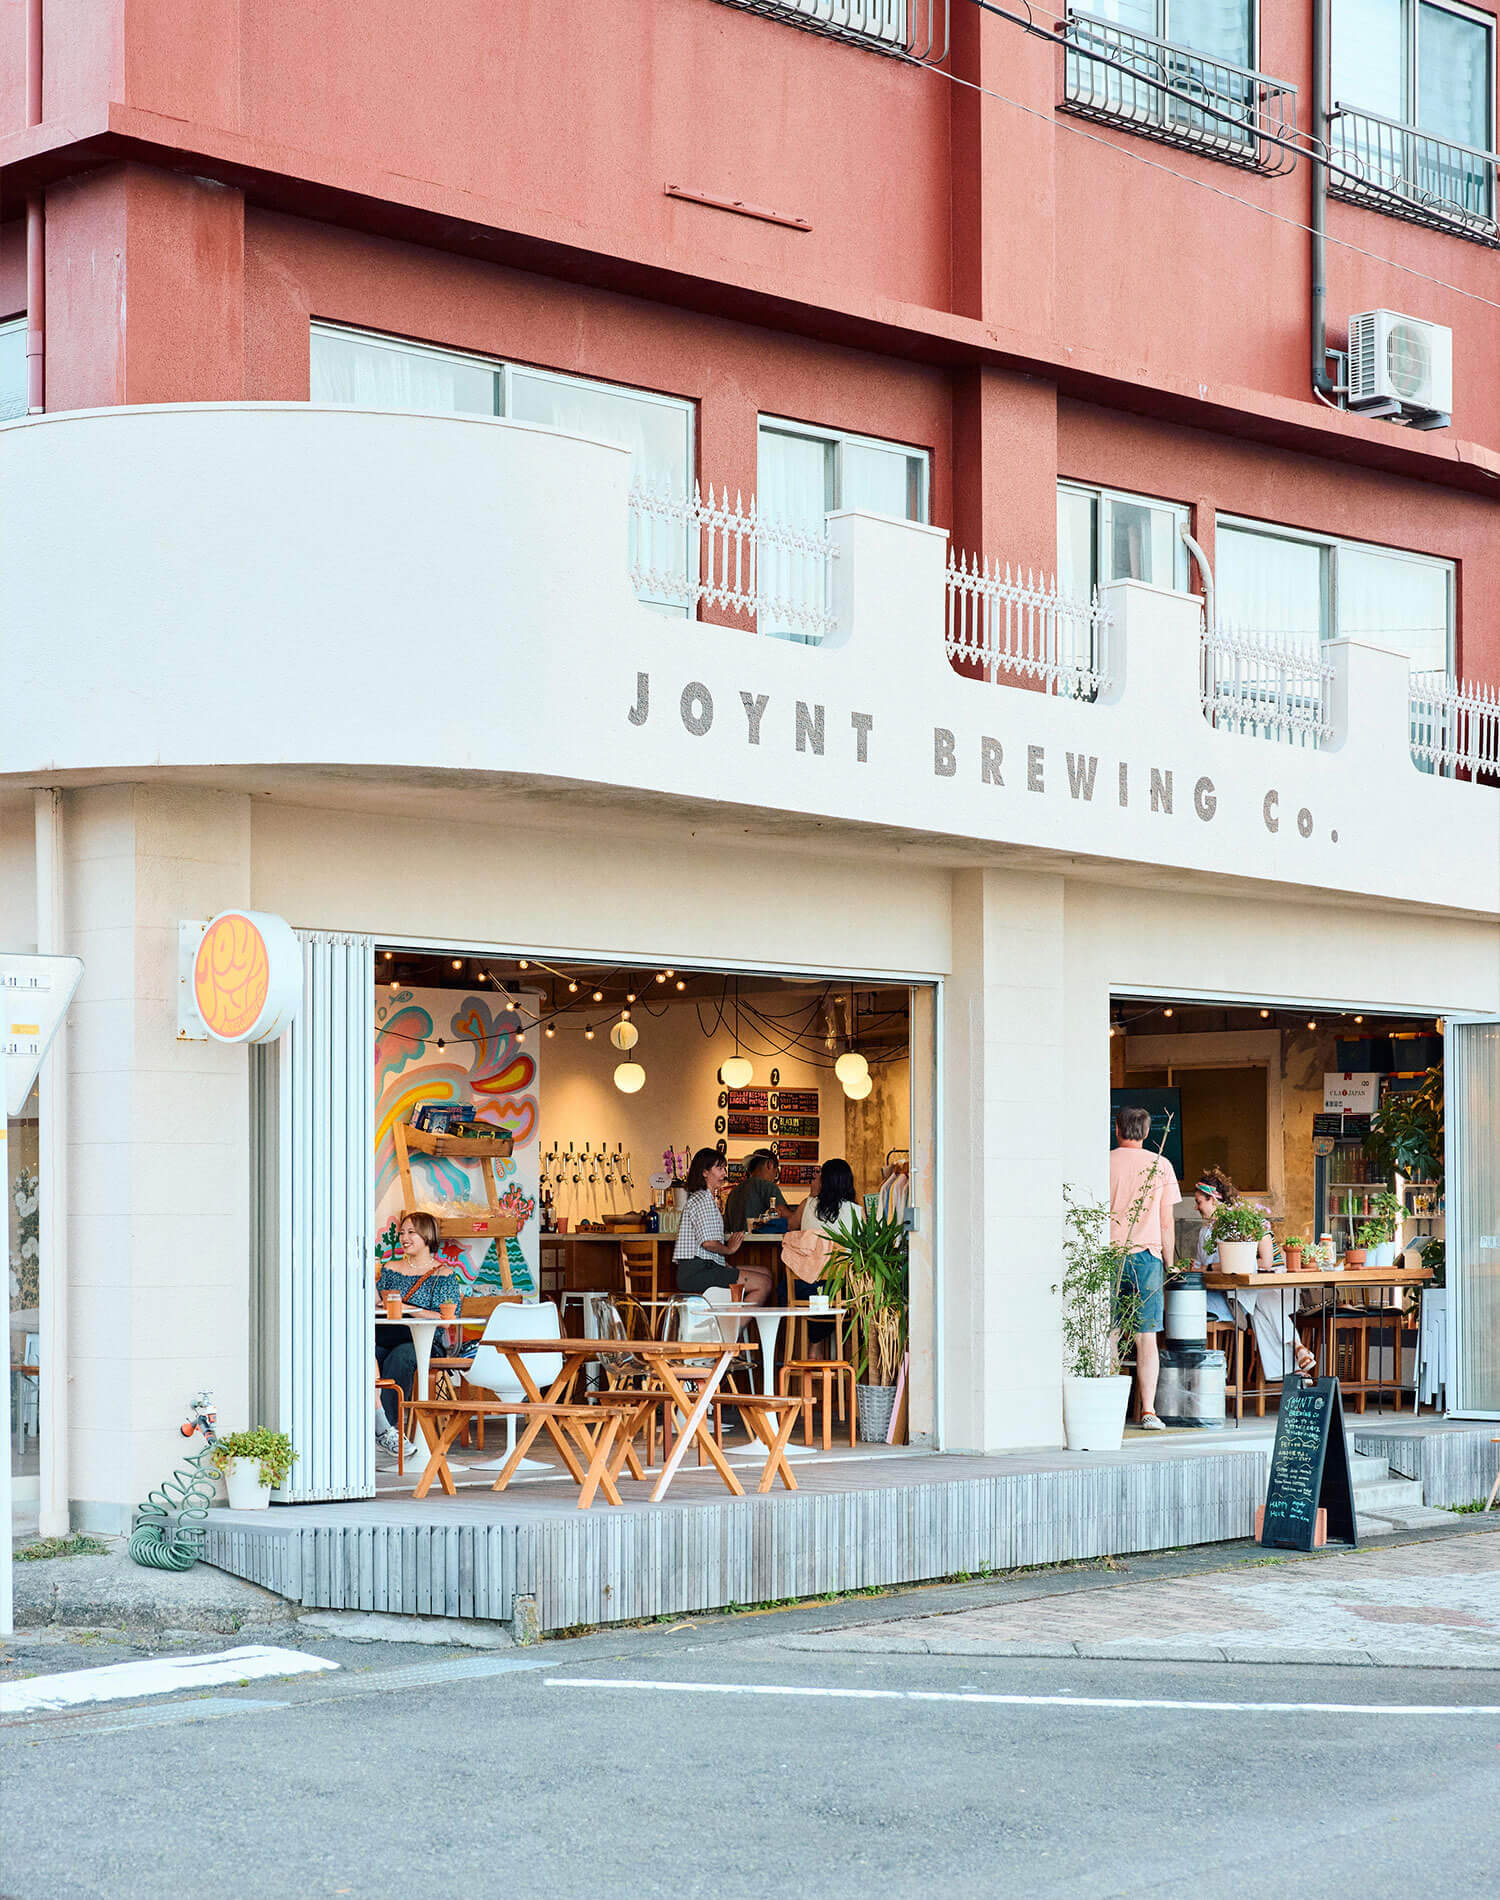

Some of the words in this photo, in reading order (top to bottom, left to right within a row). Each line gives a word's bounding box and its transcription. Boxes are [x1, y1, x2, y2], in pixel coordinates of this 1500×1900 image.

[627, 672, 874, 764] JOYNT
[934, 727, 1218, 823] BREWING
[1262, 789, 1340, 844] Co.
